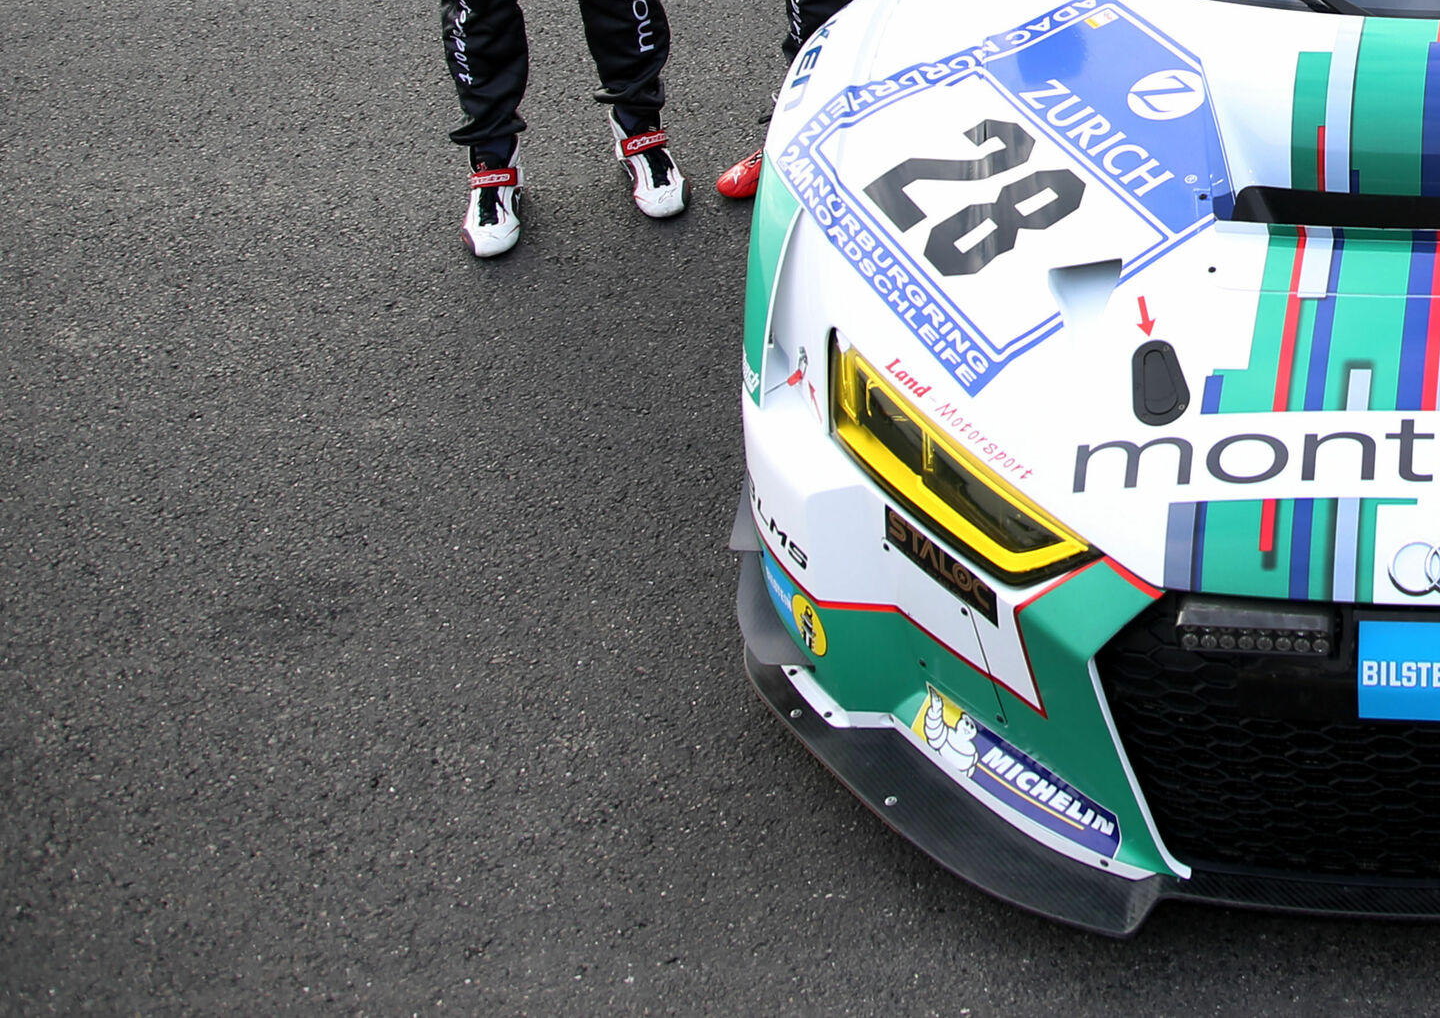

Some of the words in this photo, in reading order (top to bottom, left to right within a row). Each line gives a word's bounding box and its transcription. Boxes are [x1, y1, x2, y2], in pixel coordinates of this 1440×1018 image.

[781, 144, 816, 199] 24h
[862, 118, 1087, 277] 28
[1018, 78, 1176, 198] ZURICH
[804, 188, 977, 387] NORDSCHLEIFE
[883, 357, 929, 399] Land
[935, 402, 1035, 481] Motorsport
[889, 510, 990, 611] STALOC
[981, 745, 1115, 838] MICHELIN
